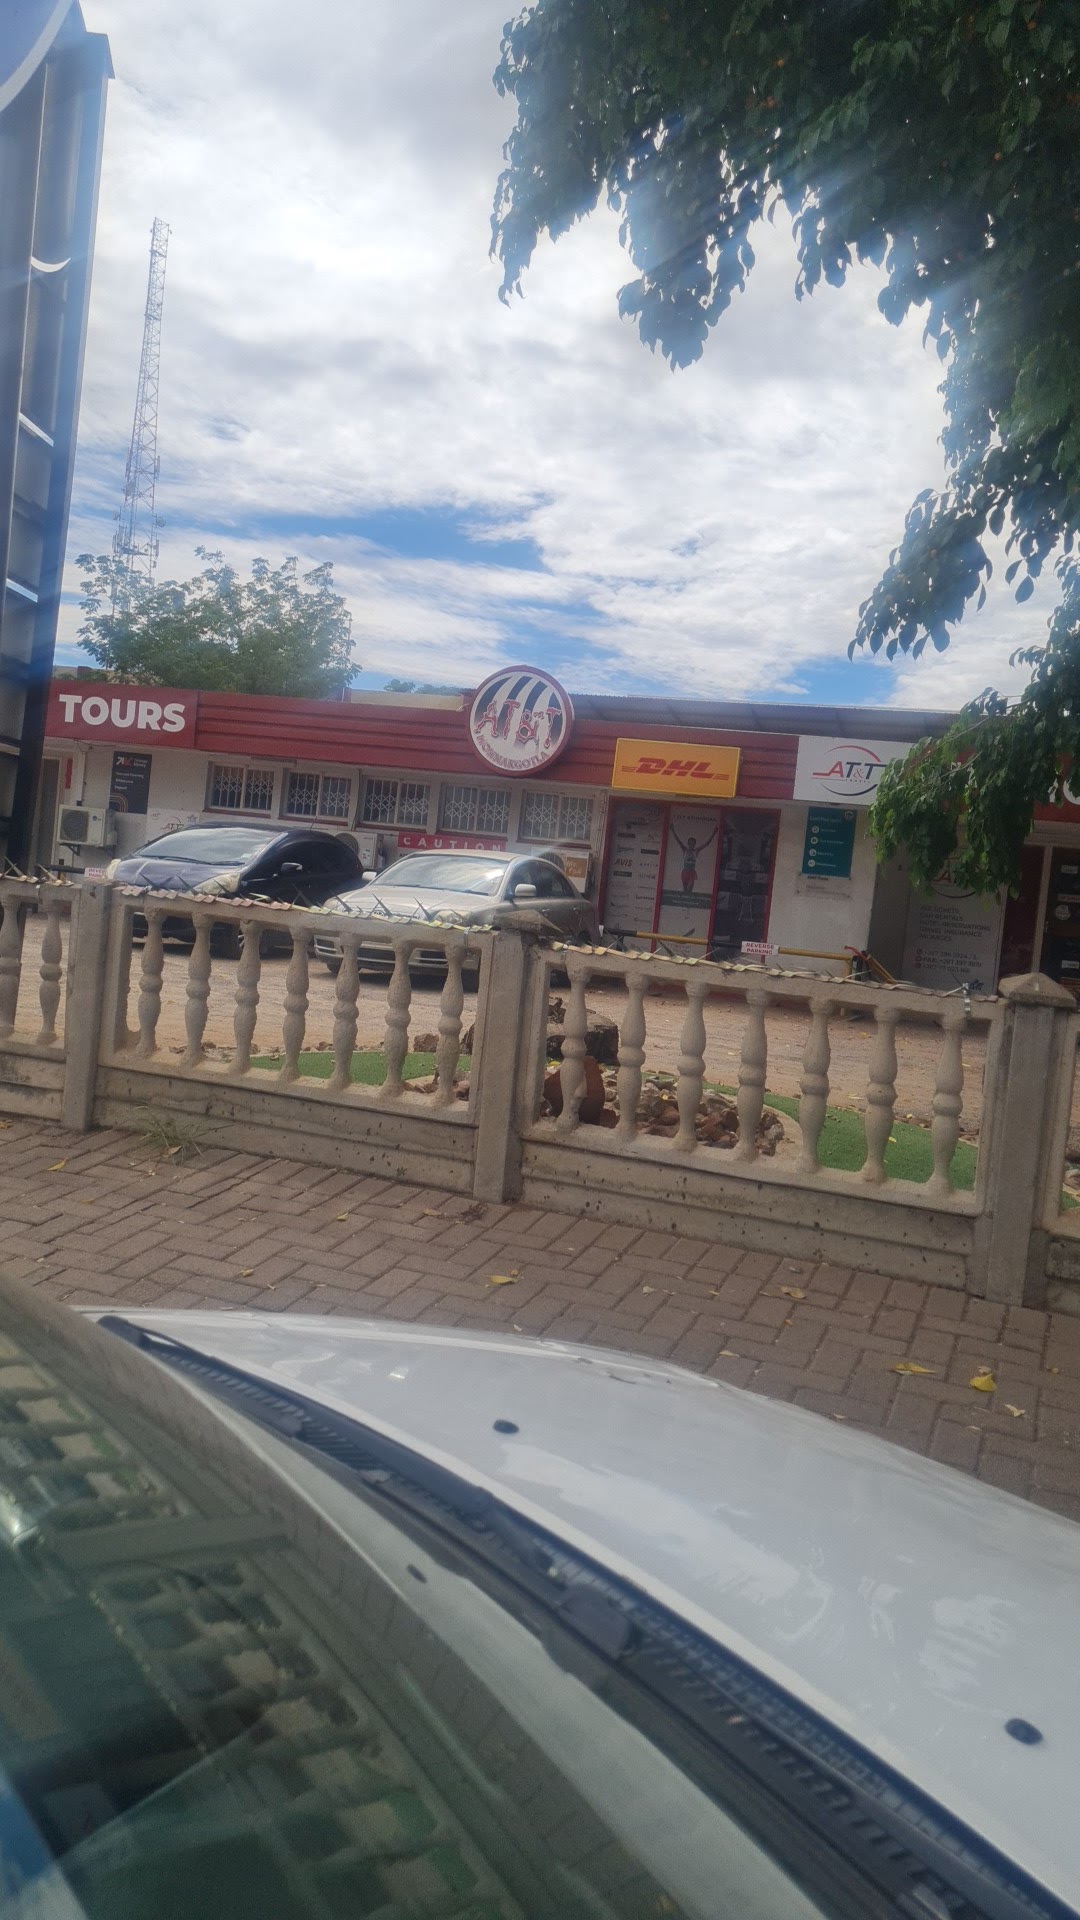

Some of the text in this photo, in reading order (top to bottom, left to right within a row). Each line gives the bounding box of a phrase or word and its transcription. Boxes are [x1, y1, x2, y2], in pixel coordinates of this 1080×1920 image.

[58, 694, 186, 733] TOURS
[636, 757, 714, 779] DHL
[816, 760, 888, 780] AT&T
[403, 837, 501, 852] CAUTION
[615, 858, 633, 867] AVIS
[746, 942, 775, 950] REVERSE
